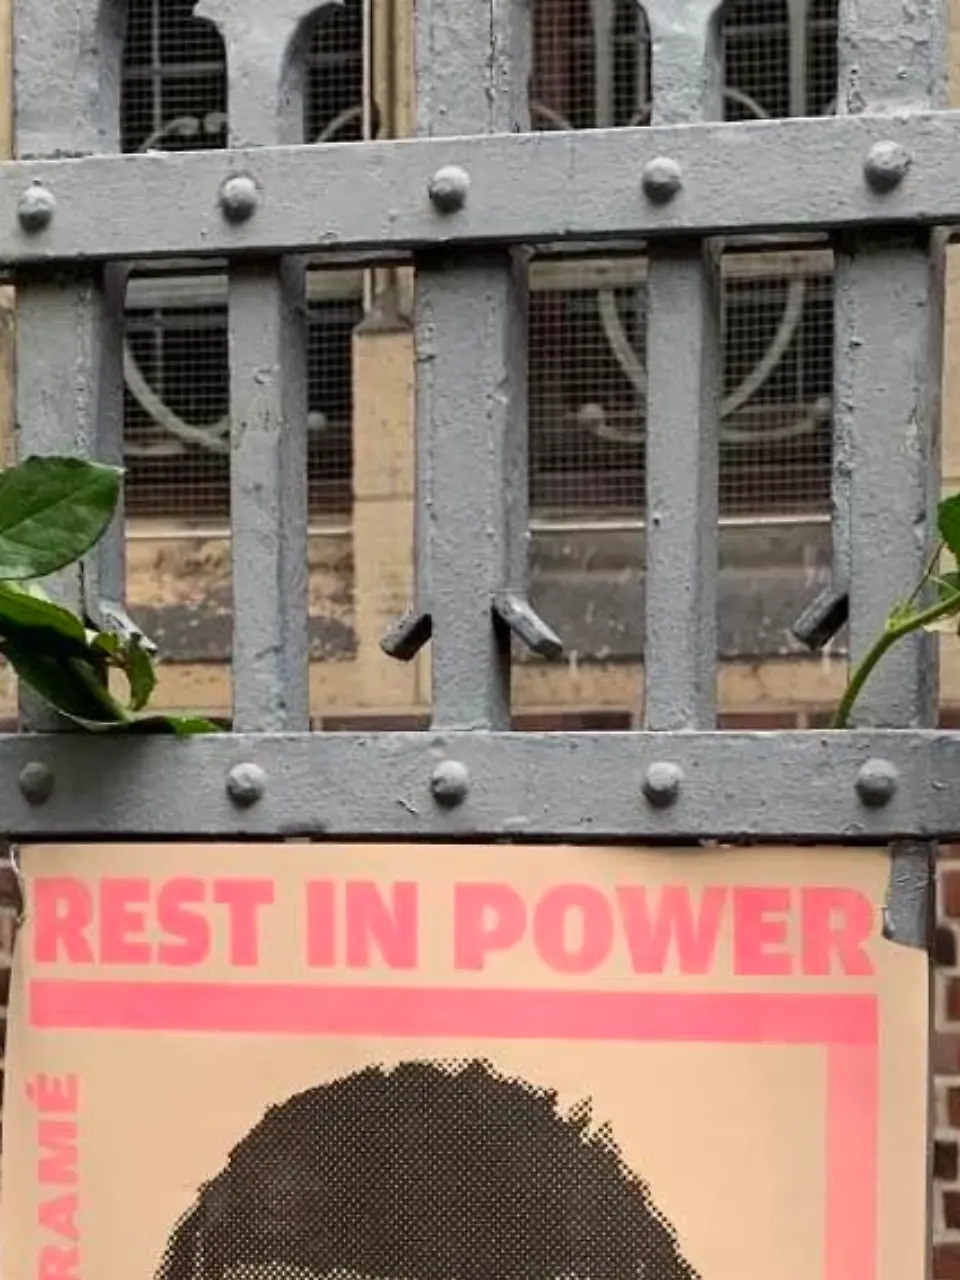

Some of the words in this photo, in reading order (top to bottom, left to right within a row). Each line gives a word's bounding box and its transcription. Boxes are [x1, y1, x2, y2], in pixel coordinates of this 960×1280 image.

[32, 877, 274, 966] REST
[305, 881, 418, 970] IN
[454, 882, 878, 976] POWER
